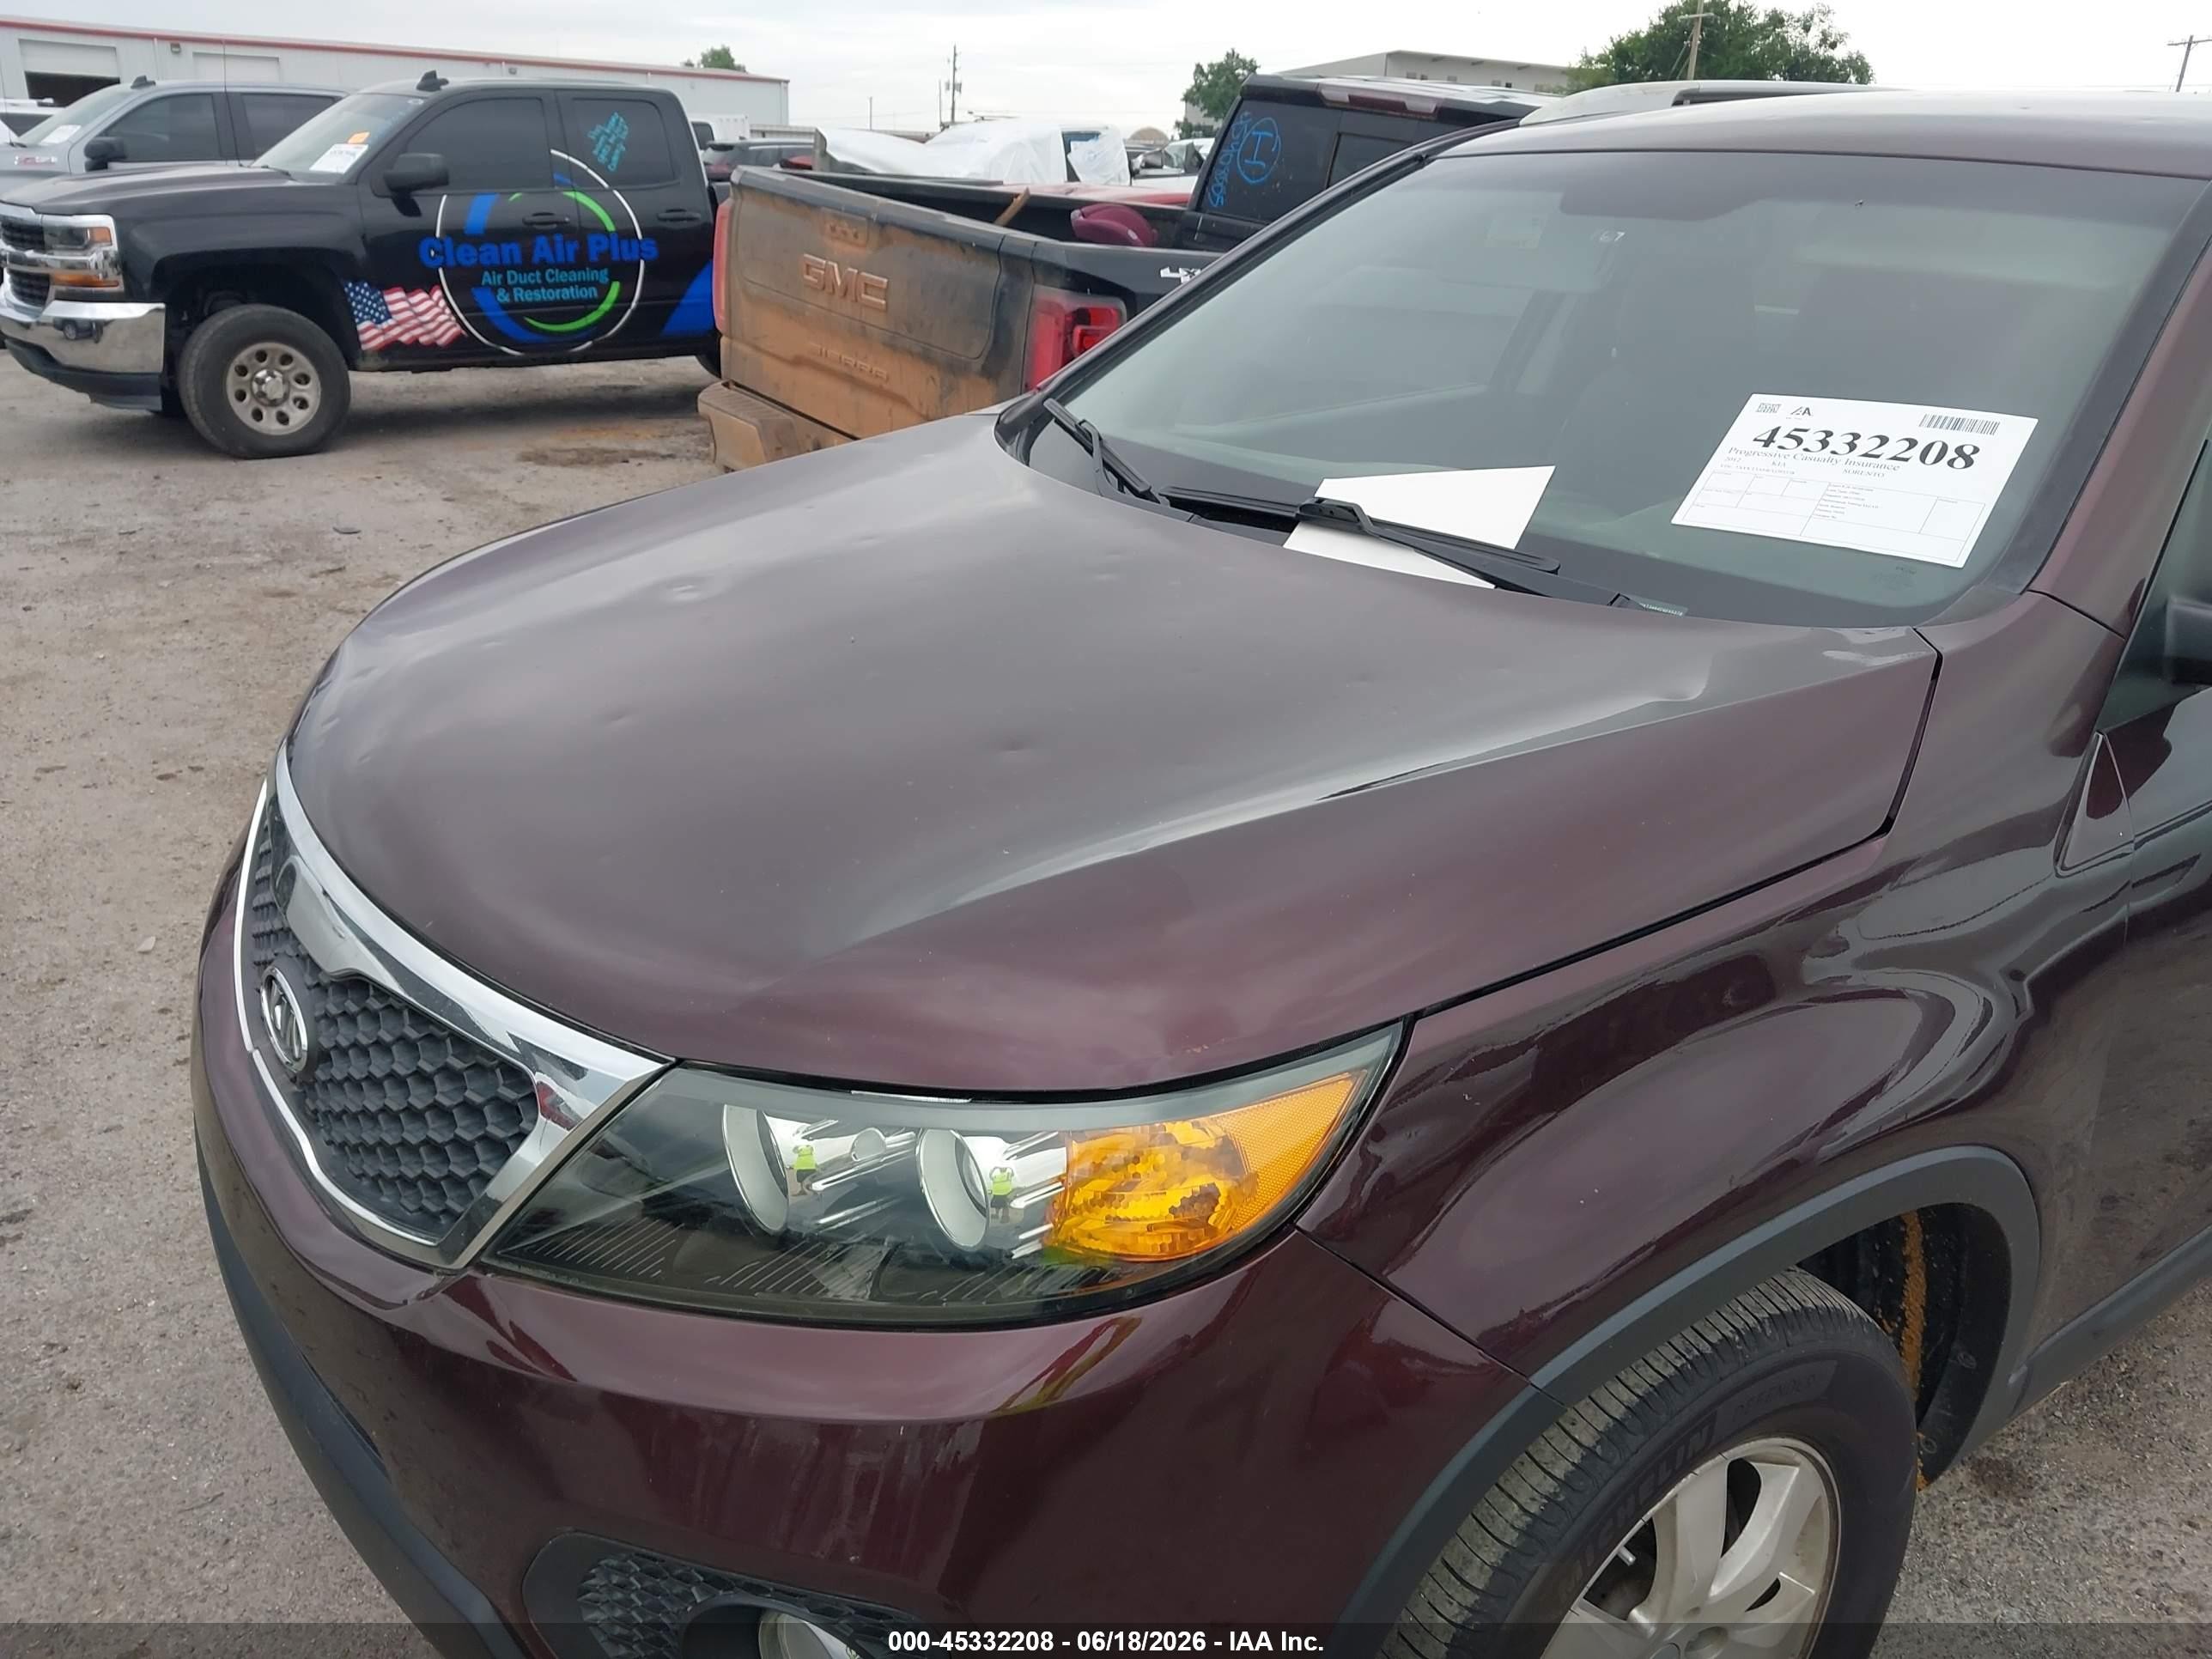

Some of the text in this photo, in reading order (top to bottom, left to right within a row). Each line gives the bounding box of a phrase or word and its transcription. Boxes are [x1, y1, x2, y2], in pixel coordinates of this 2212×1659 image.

[419, 233, 659, 268] Clean Air Plus
[481, 267, 609, 285] Air Duct Cleaning
[804, 253, 888, 312] GMC
[496, 285, 598, 302] & Restoration
[1729, 447, 1900, 471] Progressive Casualty Insurance
[1753, 426, 1980, 470] 45332208
